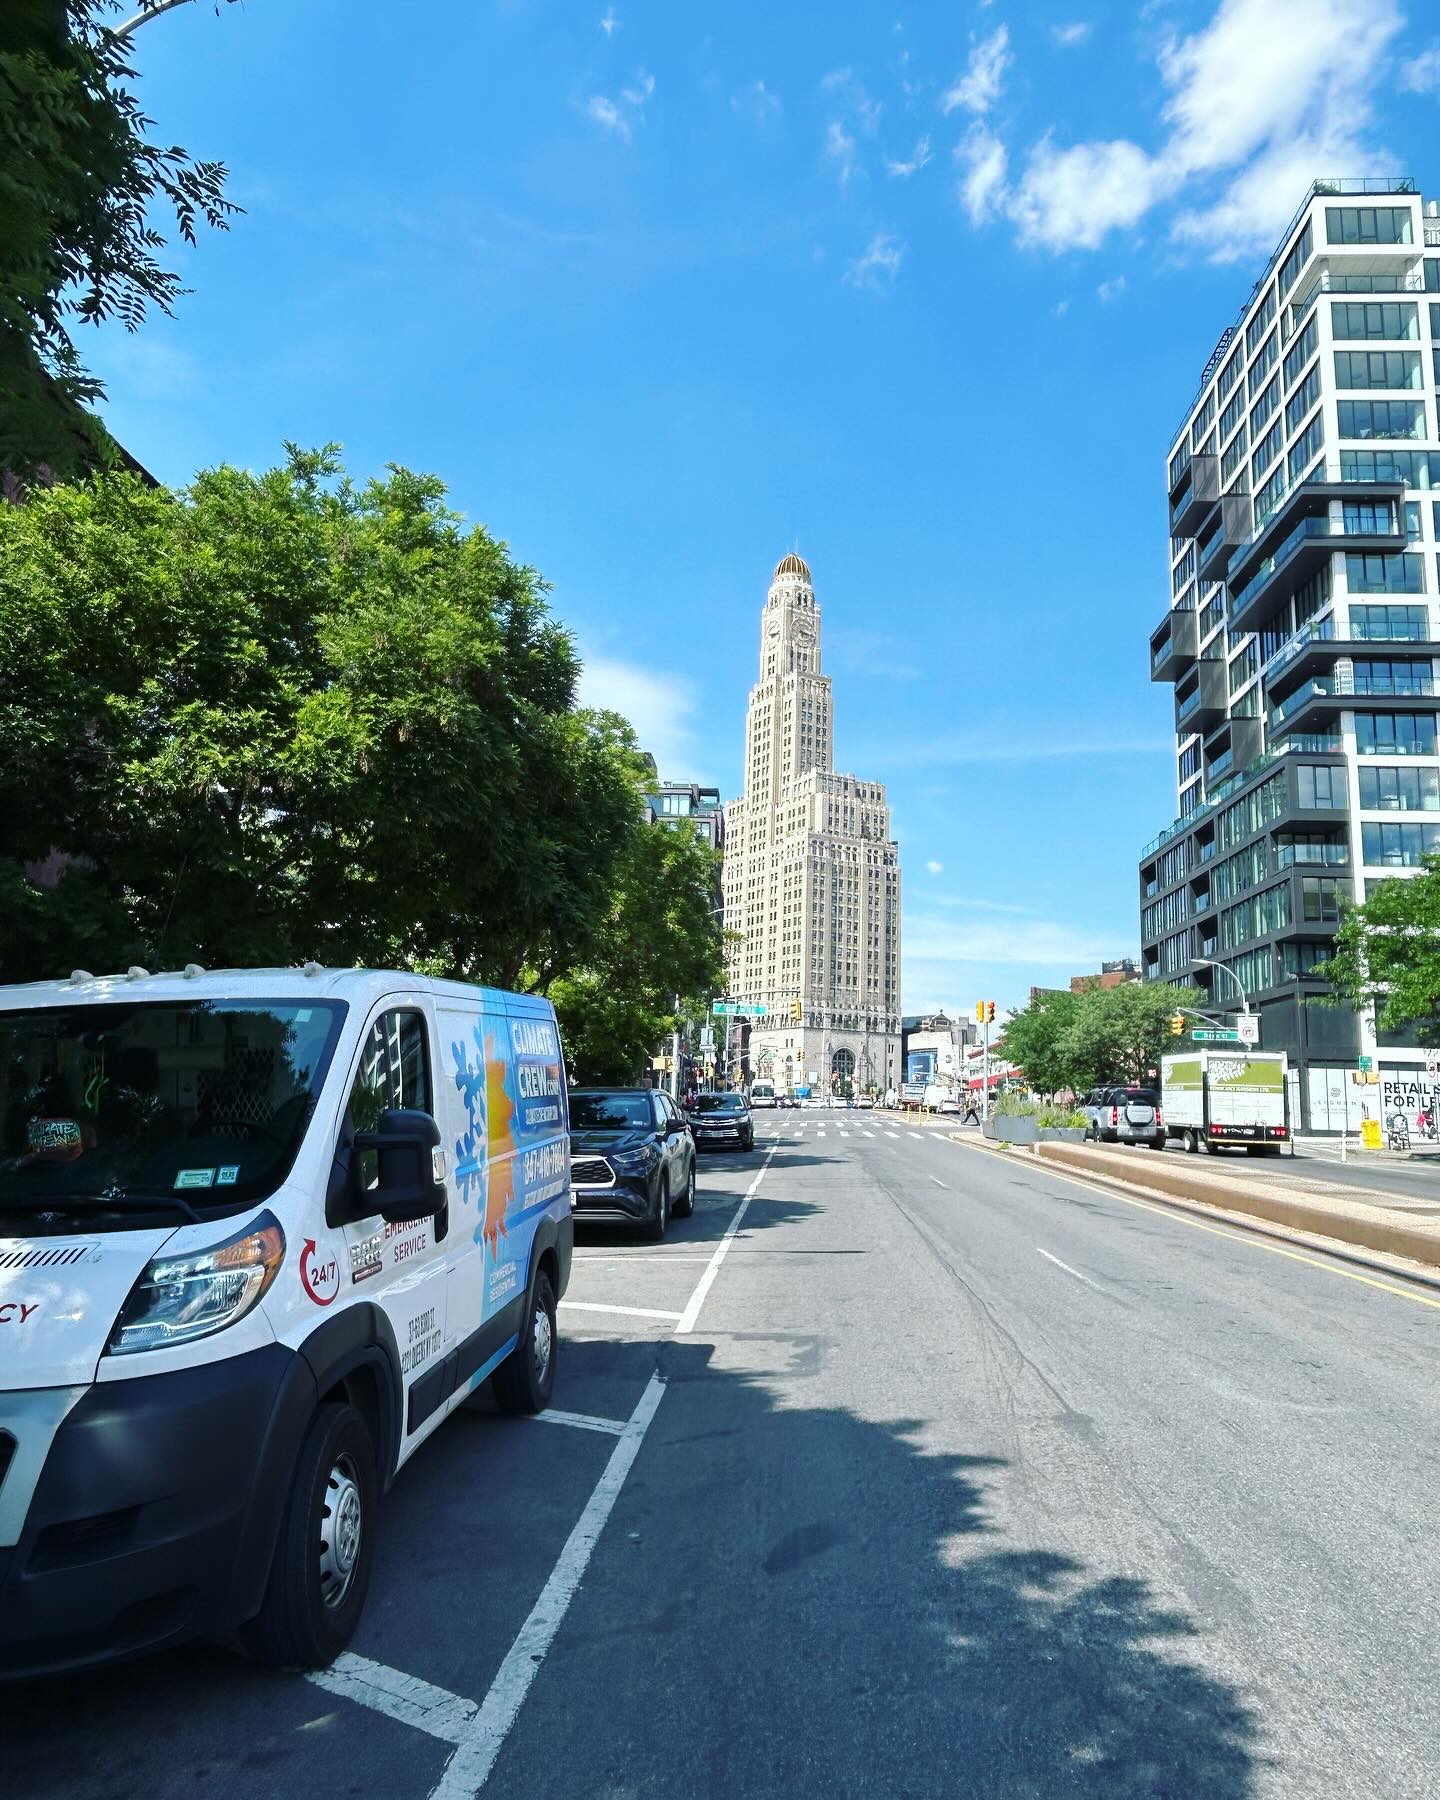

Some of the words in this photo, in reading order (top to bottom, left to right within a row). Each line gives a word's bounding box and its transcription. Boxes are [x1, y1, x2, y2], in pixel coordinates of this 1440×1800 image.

[512, 1022, 555, 1056] CLIMATE
[518, 1065, 547, 1098] CREW
[1384, 1082, 1430, 1094] RETAIL
[1385, 1096, 1415, 1108] FOR
[385, 1215, 432, 1239] EMERGE
[394, 1233, 426, 1263] SERVICE
[312, 1261, 336, 1287] 24/7
[0, 1303, 39, 1323] CY
[411, 1340, 425, 1369] QUEENS
